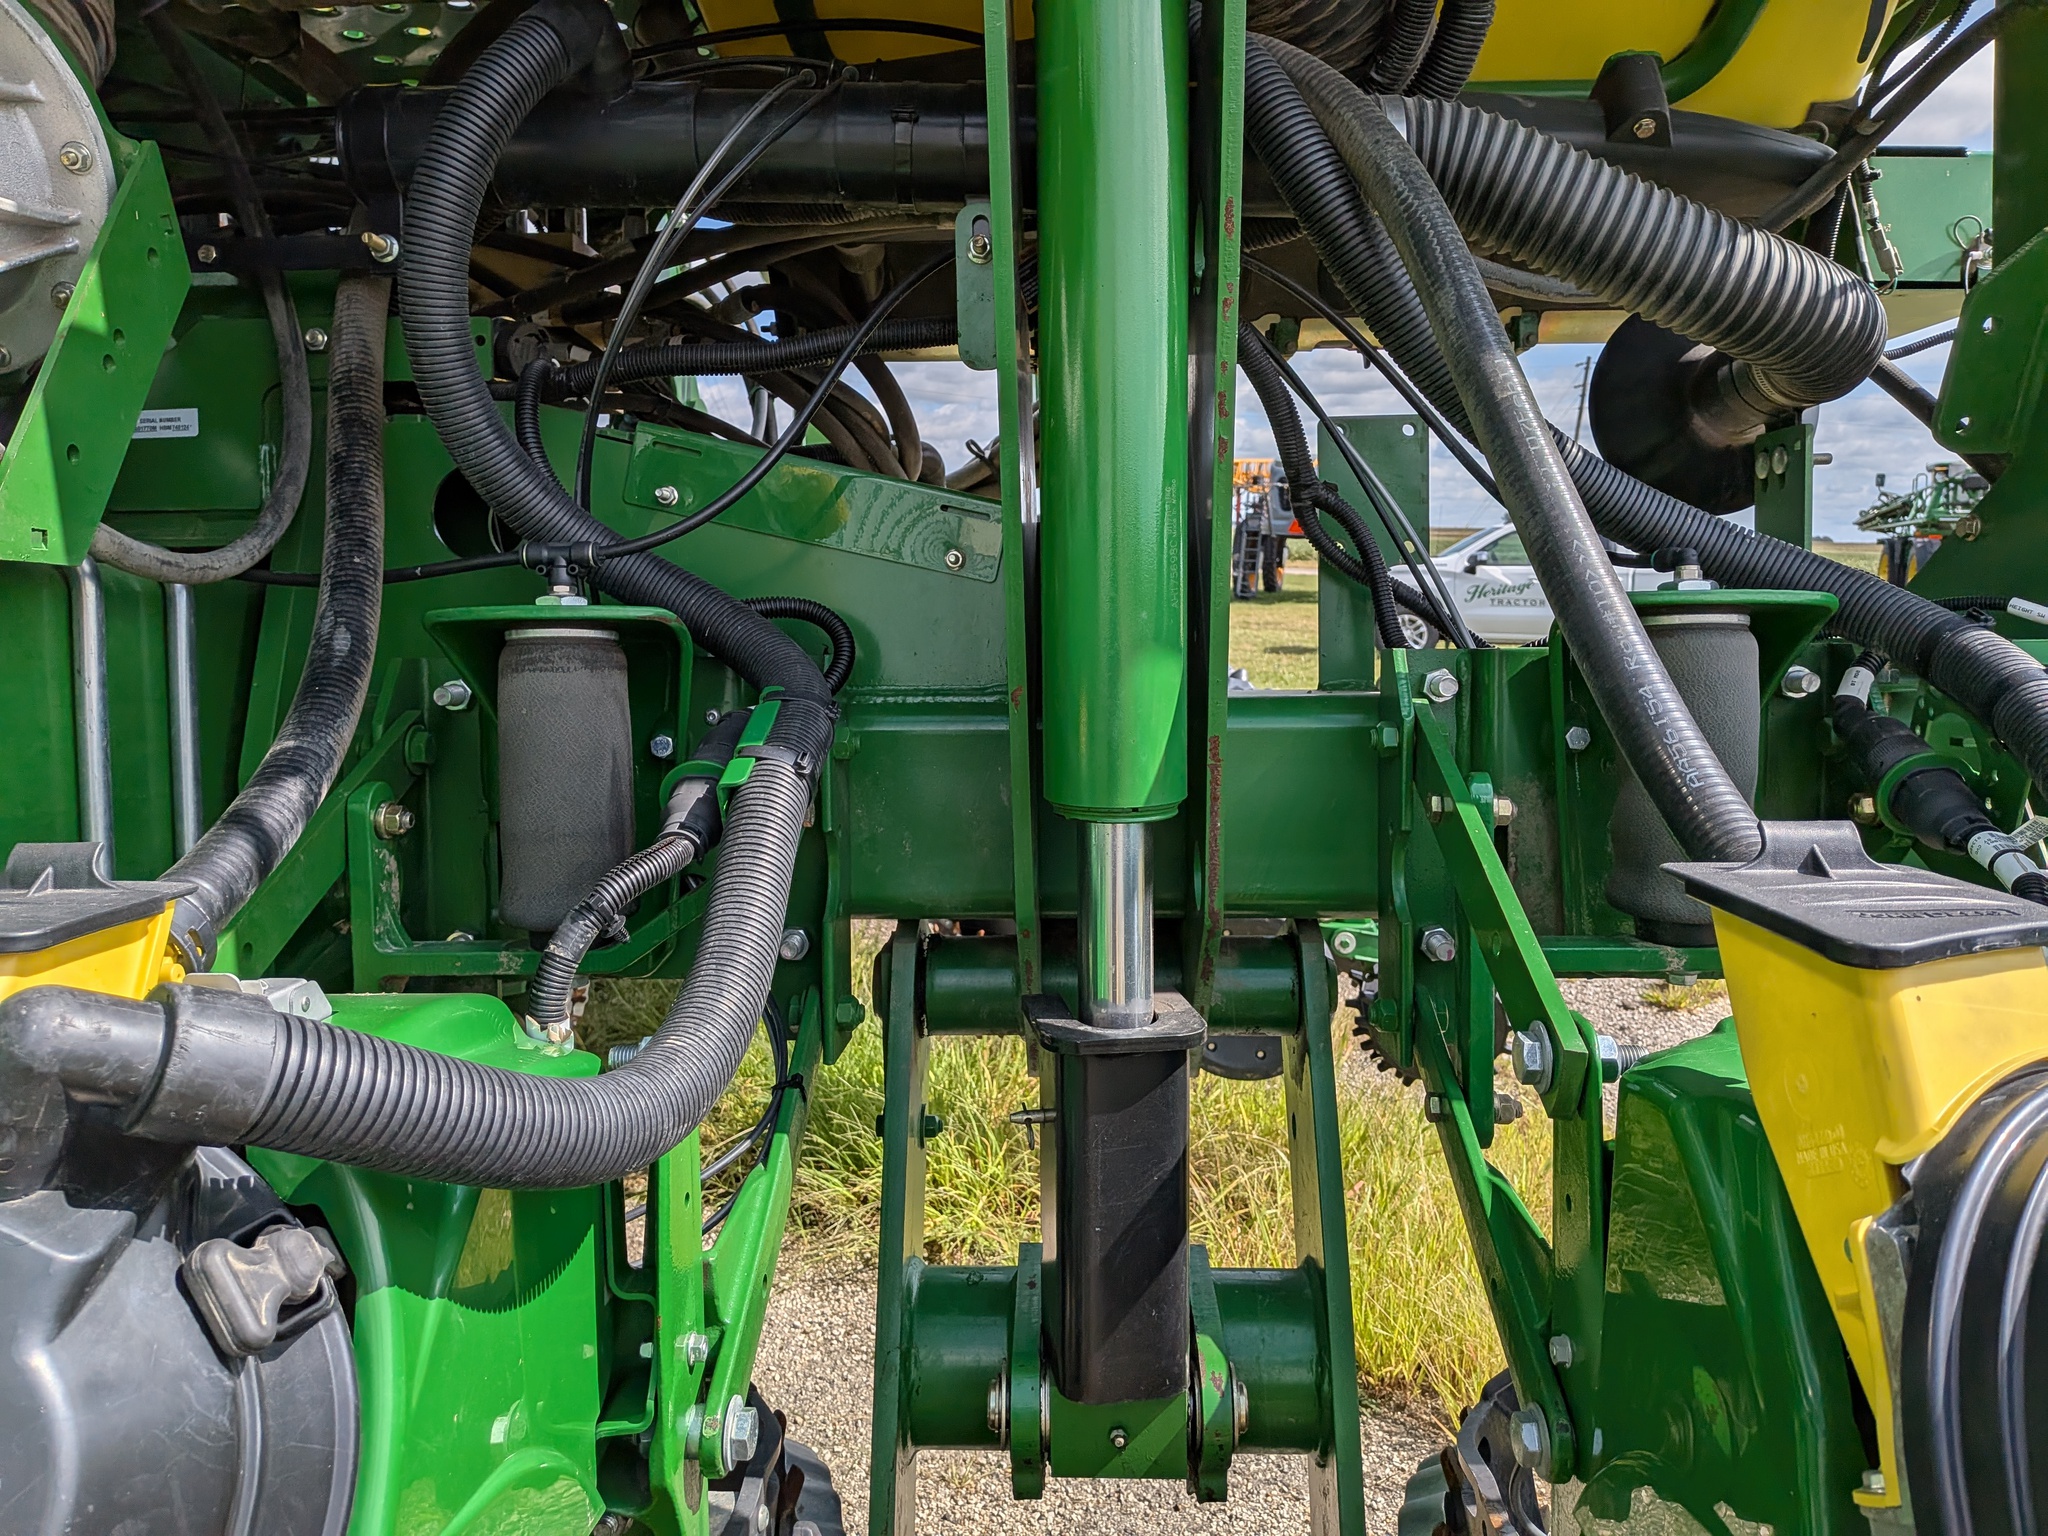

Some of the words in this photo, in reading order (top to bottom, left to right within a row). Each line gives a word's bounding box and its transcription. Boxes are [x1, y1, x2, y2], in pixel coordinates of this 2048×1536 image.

[1464, 579, 1536, 602] Heritage
[1490, 598, 1546, 607] TRACTOR
[2009, 603, 2034, 614] HEIGHT
